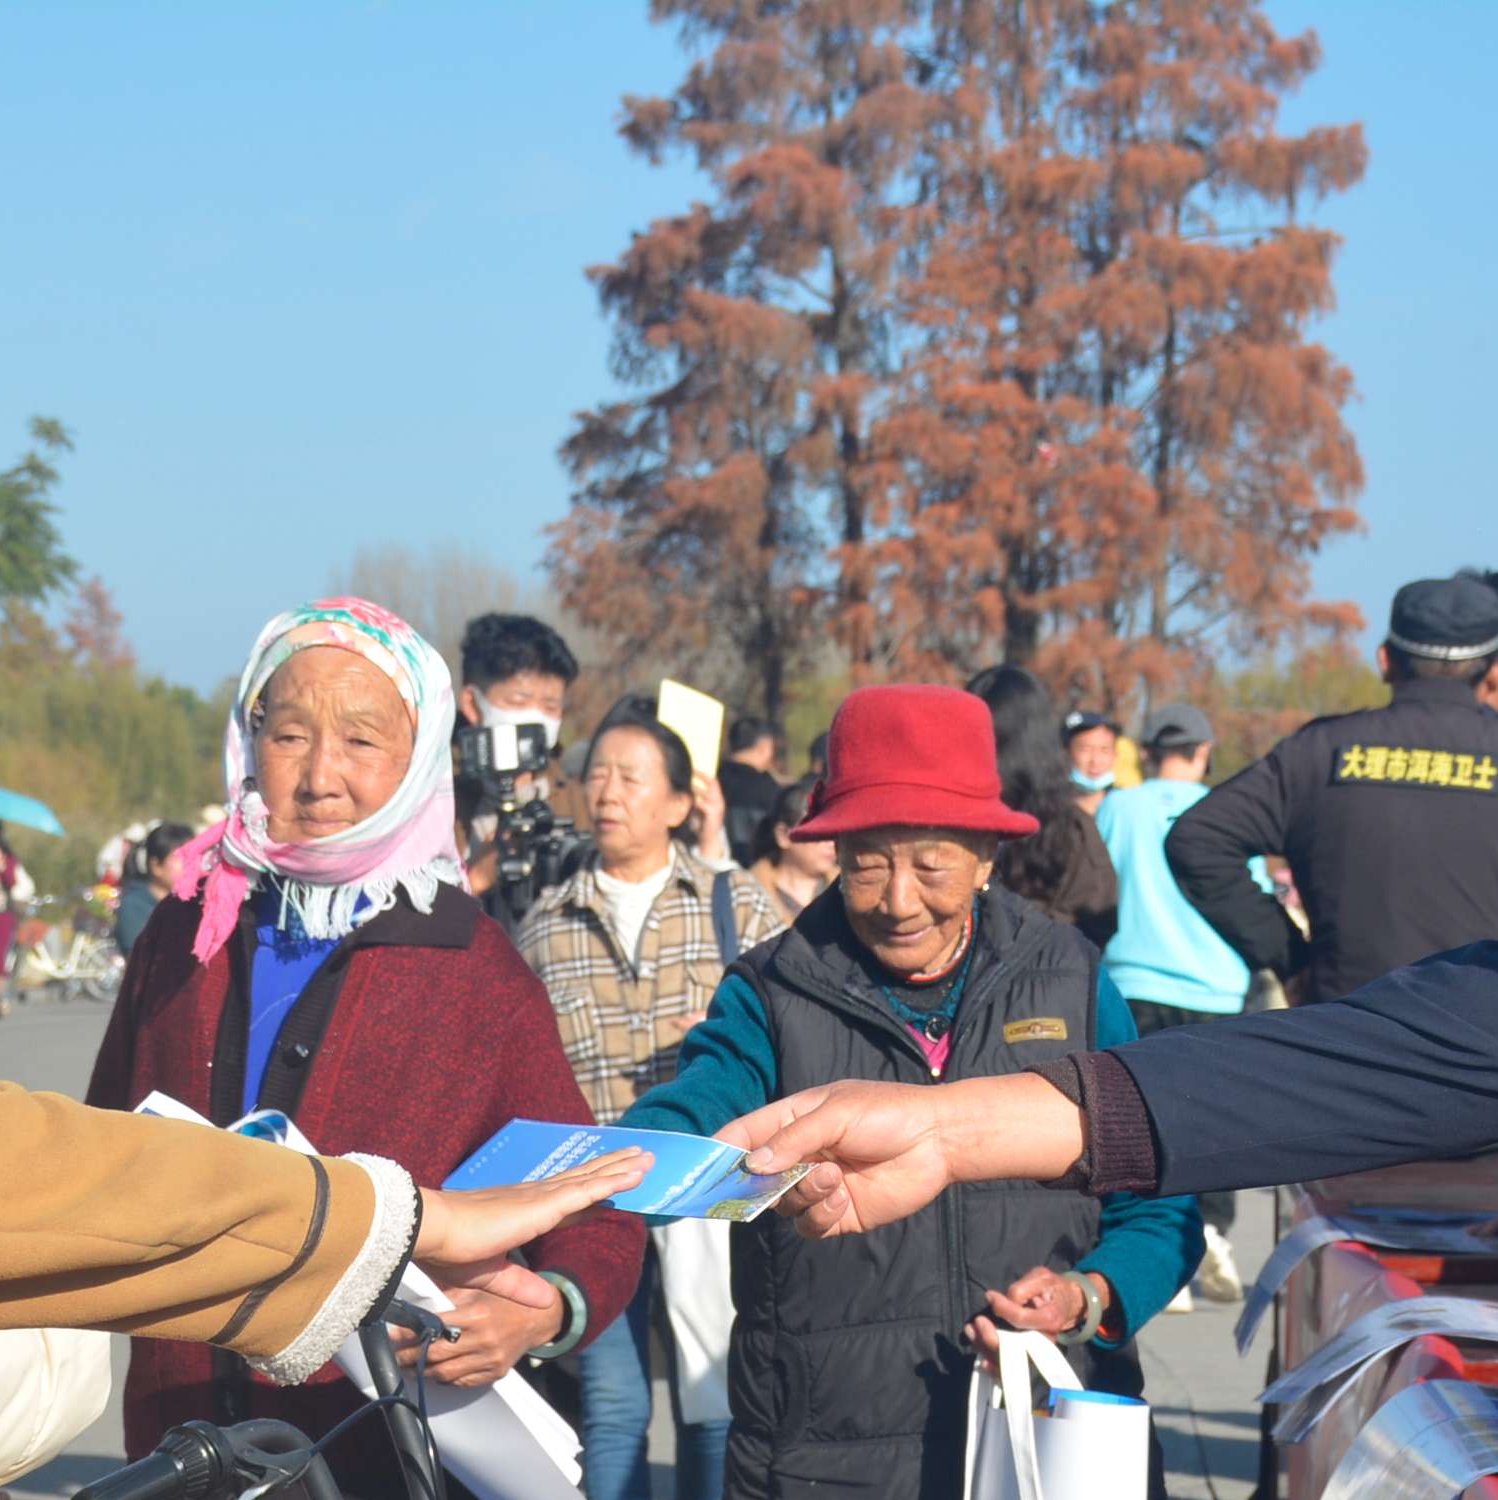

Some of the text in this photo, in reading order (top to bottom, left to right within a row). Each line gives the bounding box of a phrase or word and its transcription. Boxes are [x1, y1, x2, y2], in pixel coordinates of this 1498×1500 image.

[1339, 743, 1498, 790] 大理市洱海卫士
